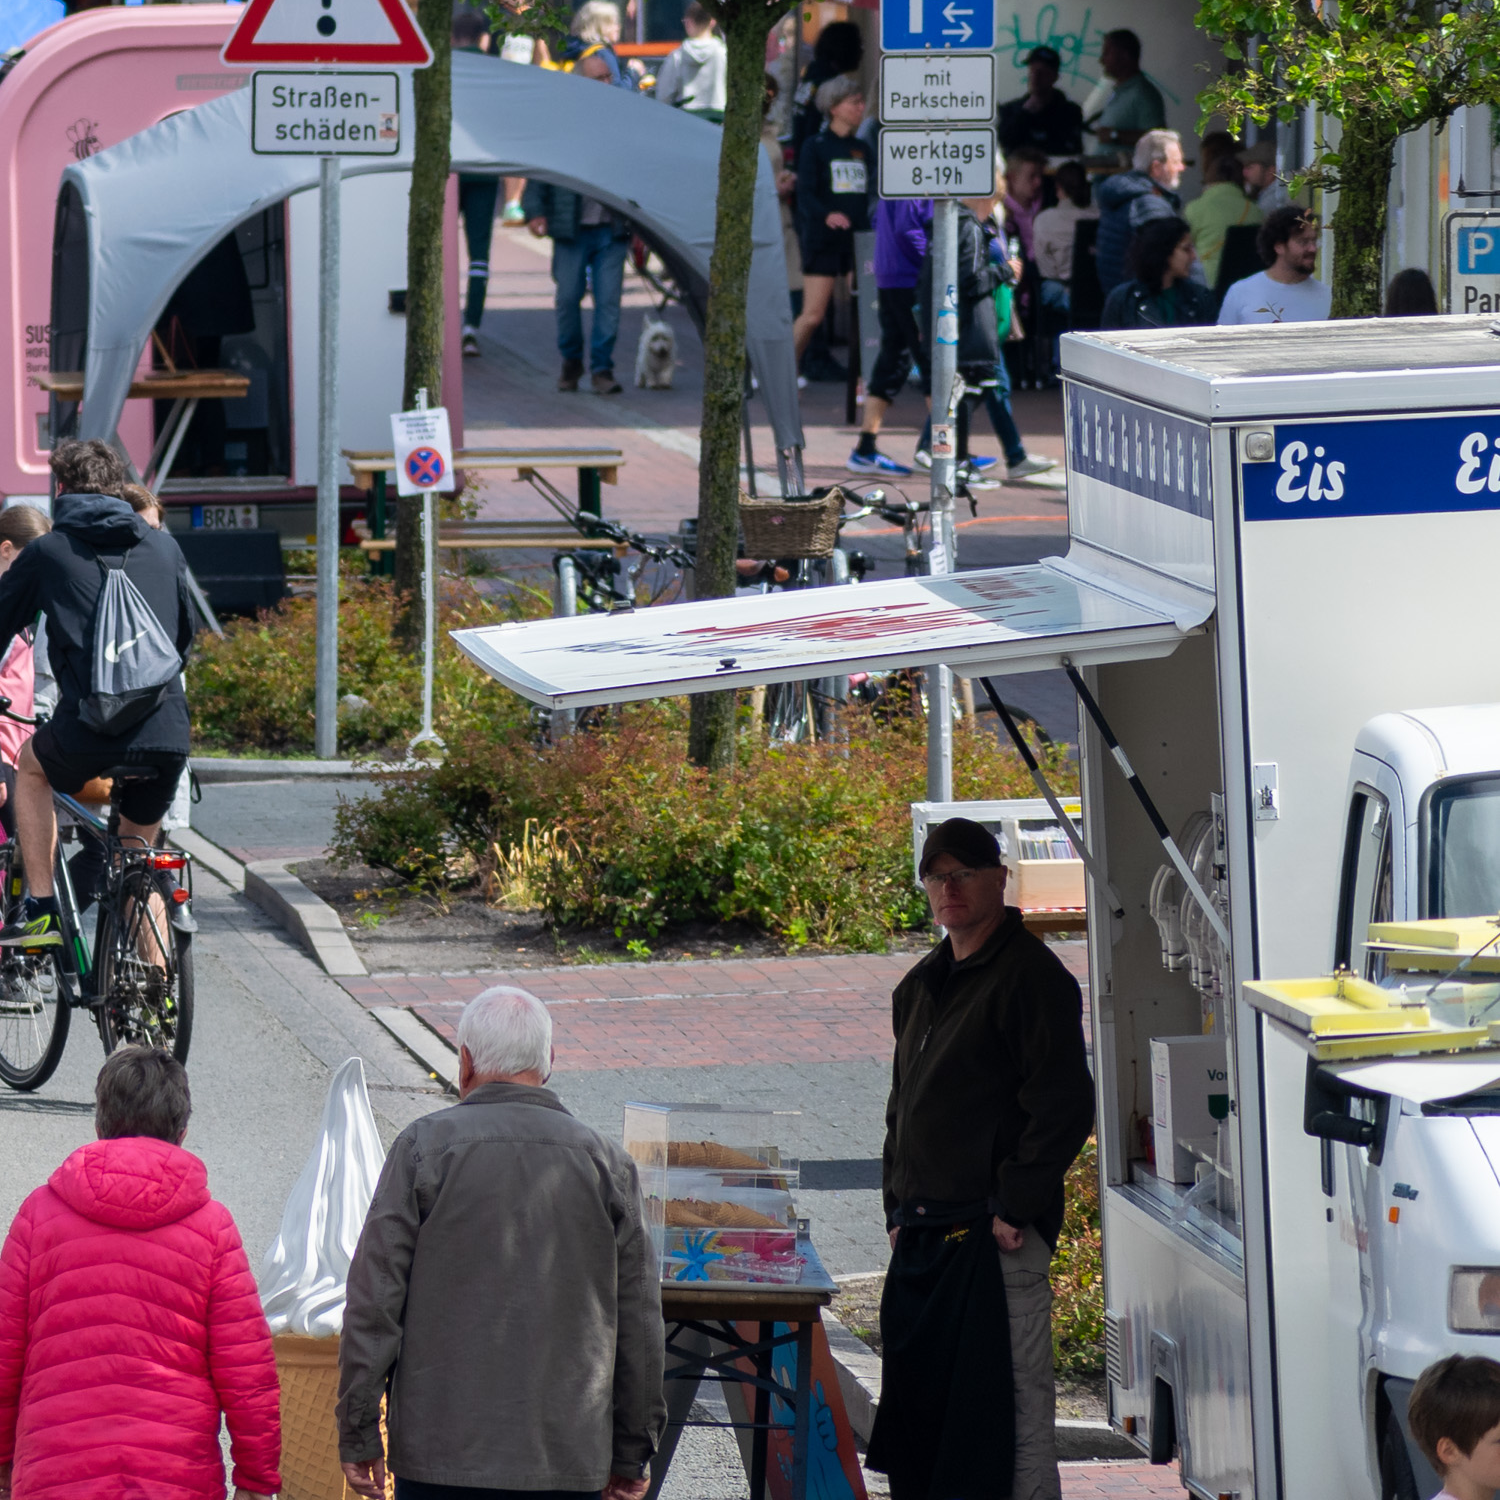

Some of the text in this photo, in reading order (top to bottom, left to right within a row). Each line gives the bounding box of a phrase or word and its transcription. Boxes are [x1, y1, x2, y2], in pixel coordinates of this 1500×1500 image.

[924, 69, 952, 86] mit
[271, 85, 381, 109] Straßen-
[889, 92, 986, 109] Parkschein
[275, 118, 377, 142] schäden
[889, 140, 986, 164] werktags
[911, 165, 963, 186] 8-19h
[1468, 231, 1494, 269] P
[25, 325, 51, 344] SUS
[25, 348, 50, 358] HOFL
[1275, 440, 1346, 504] Eis
[1456, 431, 1500, 495] Ei
[203, 508, 238, 528] BRA
